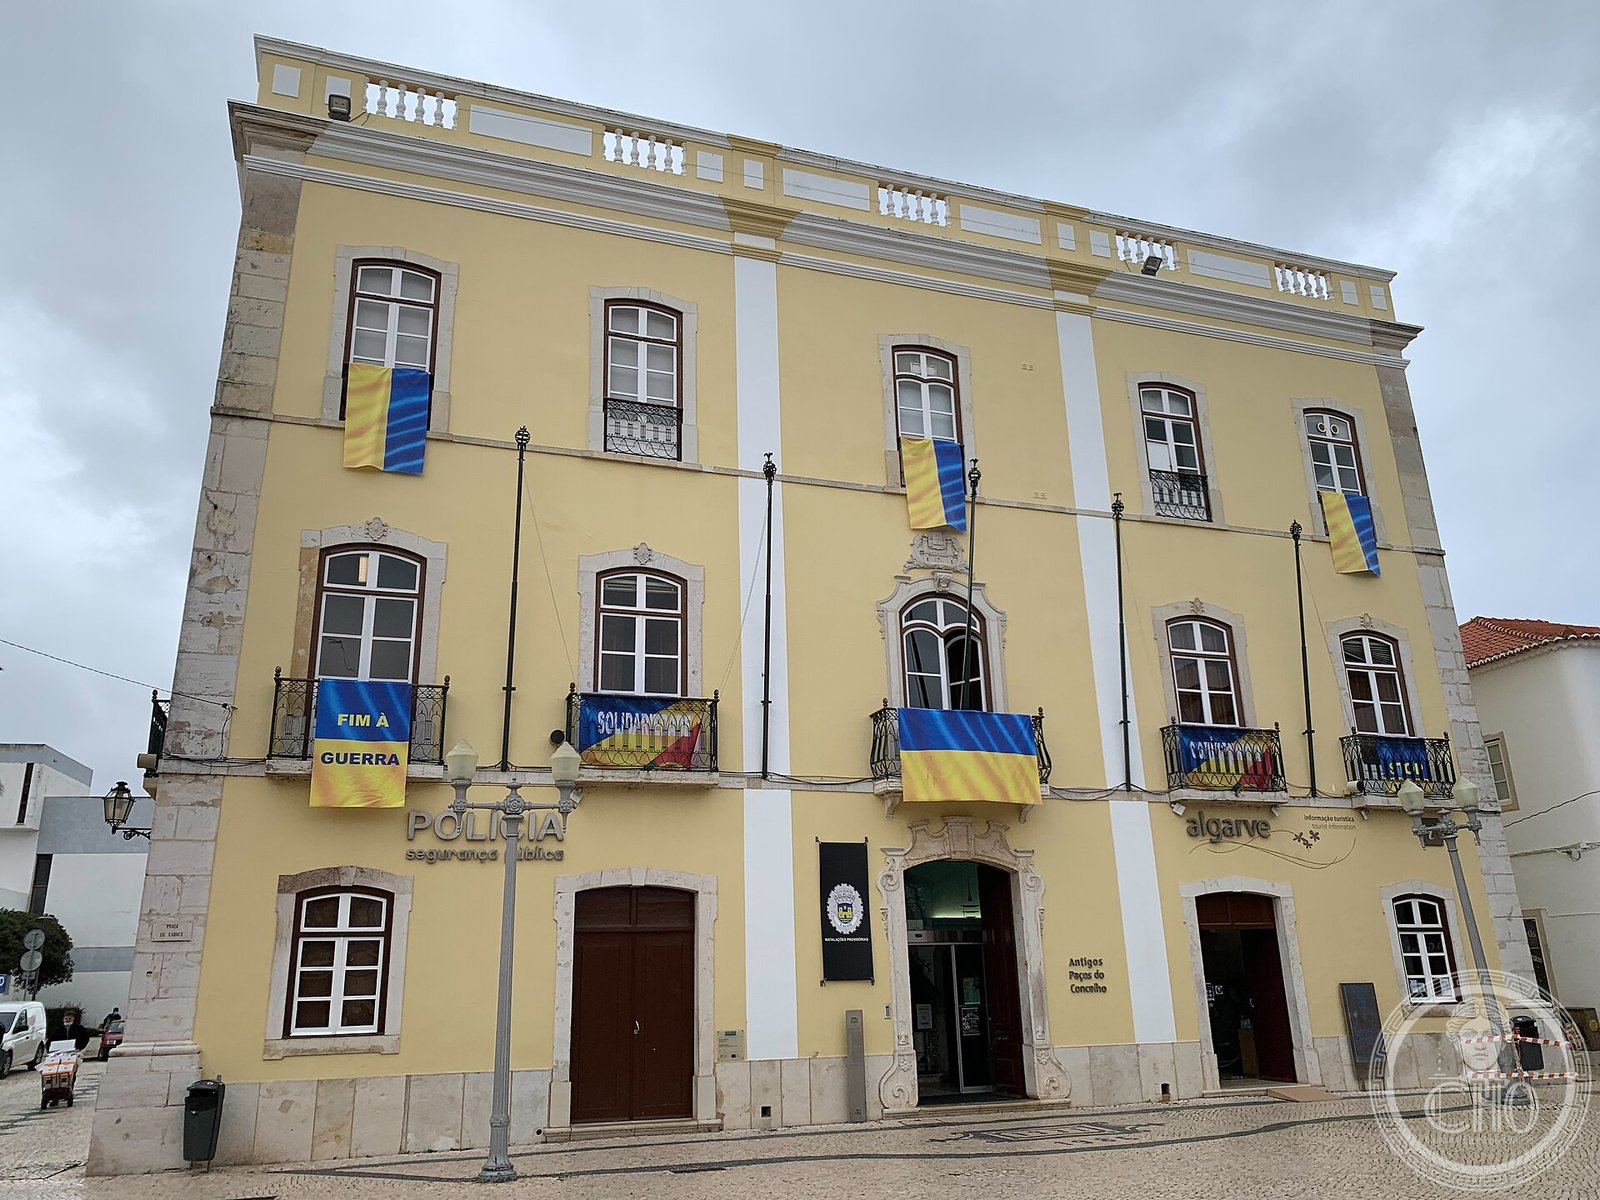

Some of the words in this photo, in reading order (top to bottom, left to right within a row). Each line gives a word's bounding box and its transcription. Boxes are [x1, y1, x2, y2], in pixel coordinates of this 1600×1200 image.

[337, 714, 371, 727] FIM
[375, 712, 390, 728] À
[320, 752, 400, 765] GUERRA
[1186, 811, 1272, 843] algarve
[406, 848, 499, 865] segurança
[517, 846, 564, 862] ública
[1069, 957, 1103, 969] Antigos
[1069, 971, 1093, 982] Paços
[1094, 969, 1105, 979] do
[1070, 983, 1108, 994] Concelho
